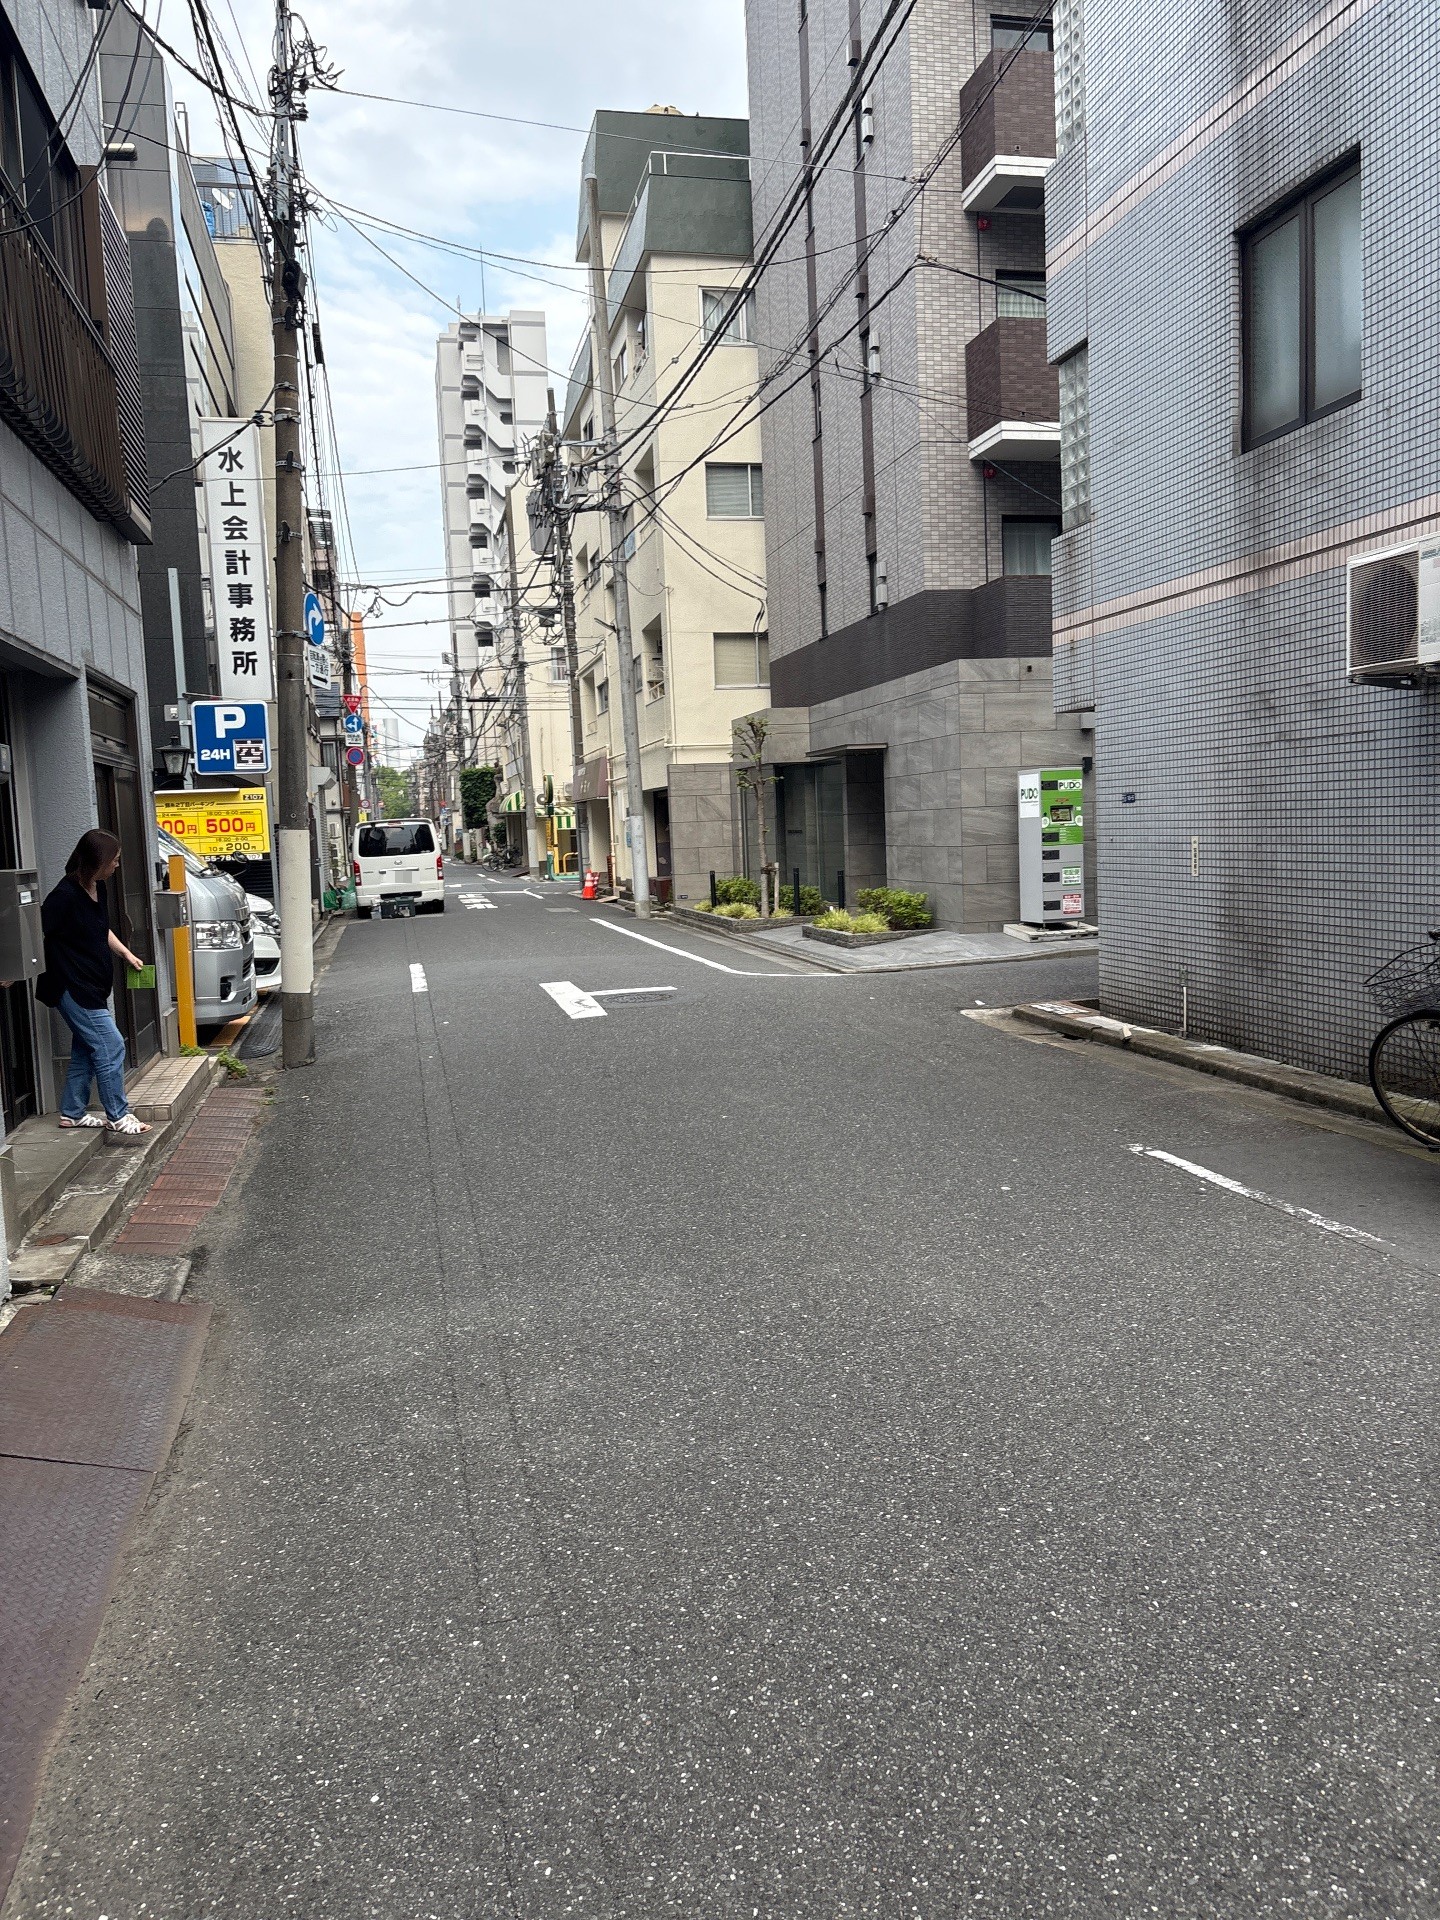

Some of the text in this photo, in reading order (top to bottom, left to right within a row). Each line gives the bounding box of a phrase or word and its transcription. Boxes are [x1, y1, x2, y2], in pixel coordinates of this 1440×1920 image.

[218, 446, 258, 676] 水上会計事務所
[214, 706, 246, 738] P
[200, 749, 231, 760] 24H
[235, 740, 264, 767] 空
[1058, 781, 1081, 789] PUDO
[1020, 787, 1039, 800] PUDO
[157, 819, 197, 834] 00円
[206, 818, 255, 833] 500円
